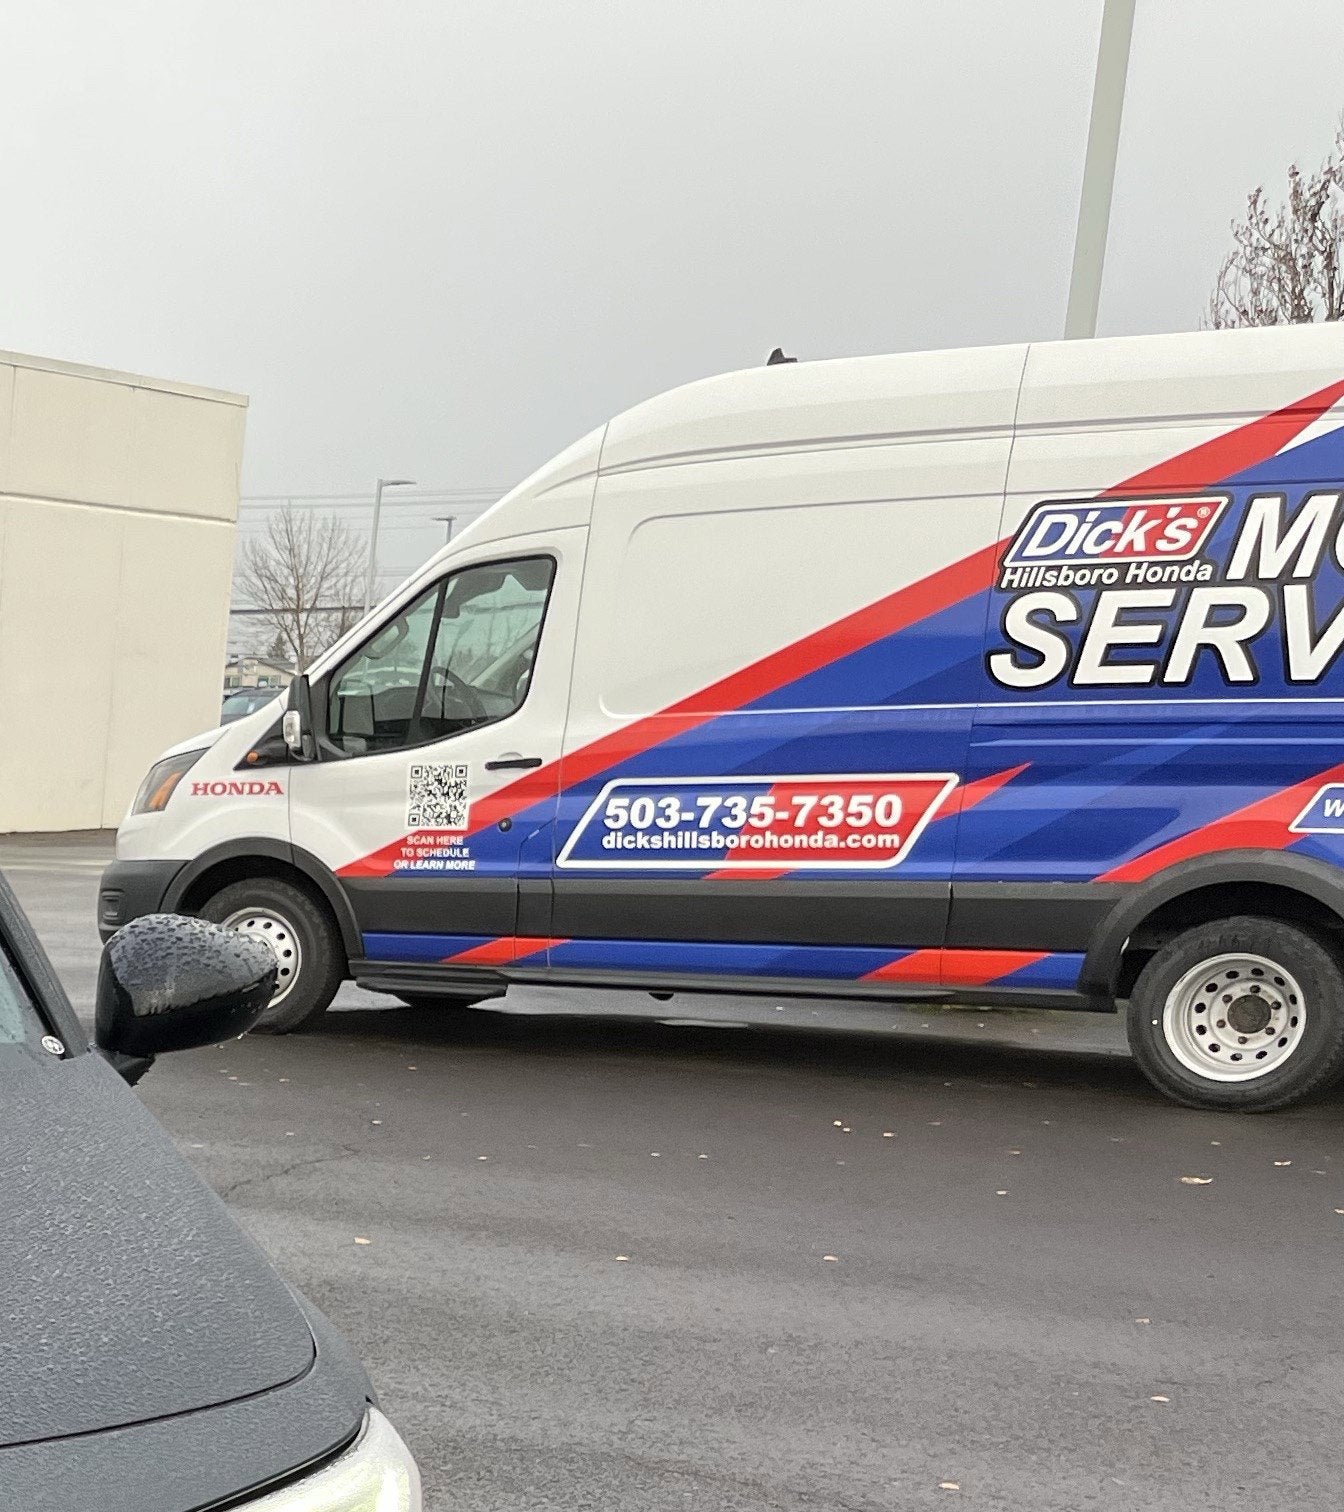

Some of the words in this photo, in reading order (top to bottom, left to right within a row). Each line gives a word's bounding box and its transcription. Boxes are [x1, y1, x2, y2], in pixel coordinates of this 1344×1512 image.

[1226, 494, 1344, 580] M
[1001, 565, 1119, 589] Hillsboro
[1125, 560, 1213, 584] Honda
[191, 781, 284, 797] HONDA
[603, 793, 902, 829] 503-735-7350
[406, 835, 434, 845] SCAN
[436, 835, 464, 845] HERE
[602, 830, 900, 849] dickshillsborohonda.com
[400, 847, 414, 857] TO
[416, 847, 469, 858] SCHEDULE
[393, 859, 408, 869] OR
[410, 860, 444, 870] LEARN
[445, 860, 476, 870] MORE
